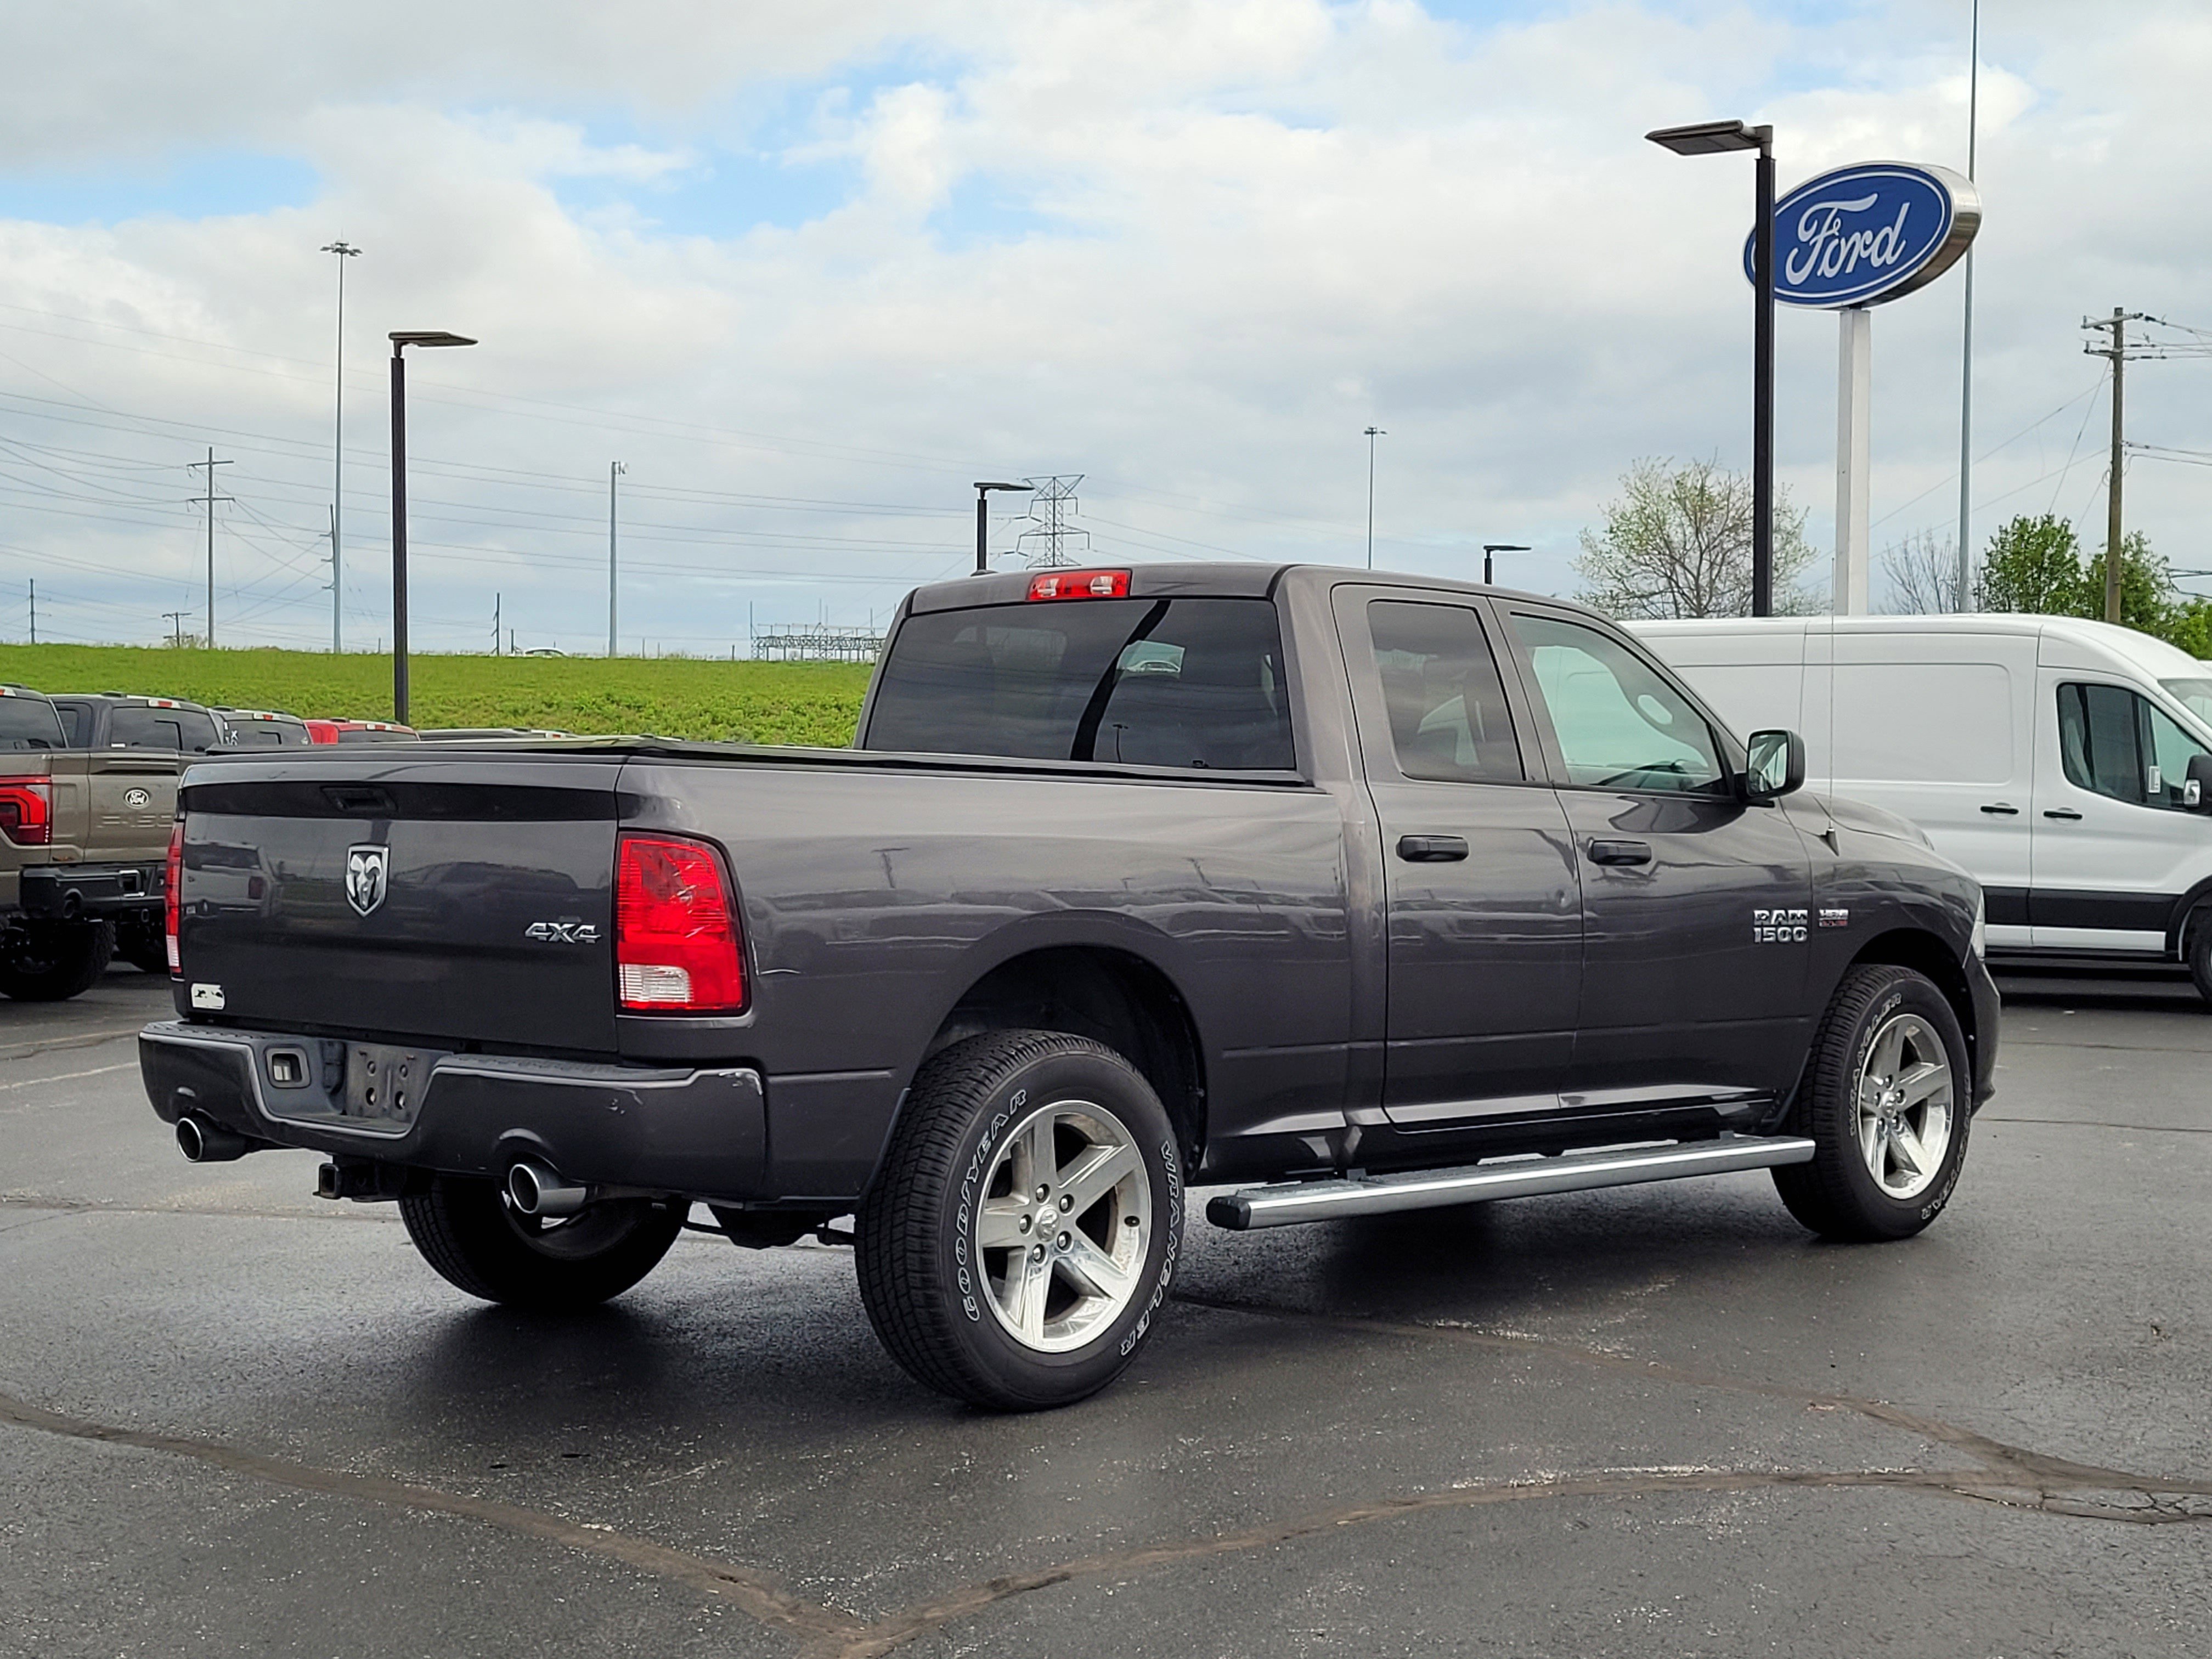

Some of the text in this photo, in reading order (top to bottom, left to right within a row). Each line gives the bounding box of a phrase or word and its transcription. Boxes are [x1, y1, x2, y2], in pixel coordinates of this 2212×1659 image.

[1786, 193, 1910, 285] Ford
[1753, 909, 1808, 926] RAM
[1753, 927, 1808, 943] 1500
[956, 1090, 1026, 1321] GOODYEAR
[1121, 1141, 1180, 1356] WRANGLER
